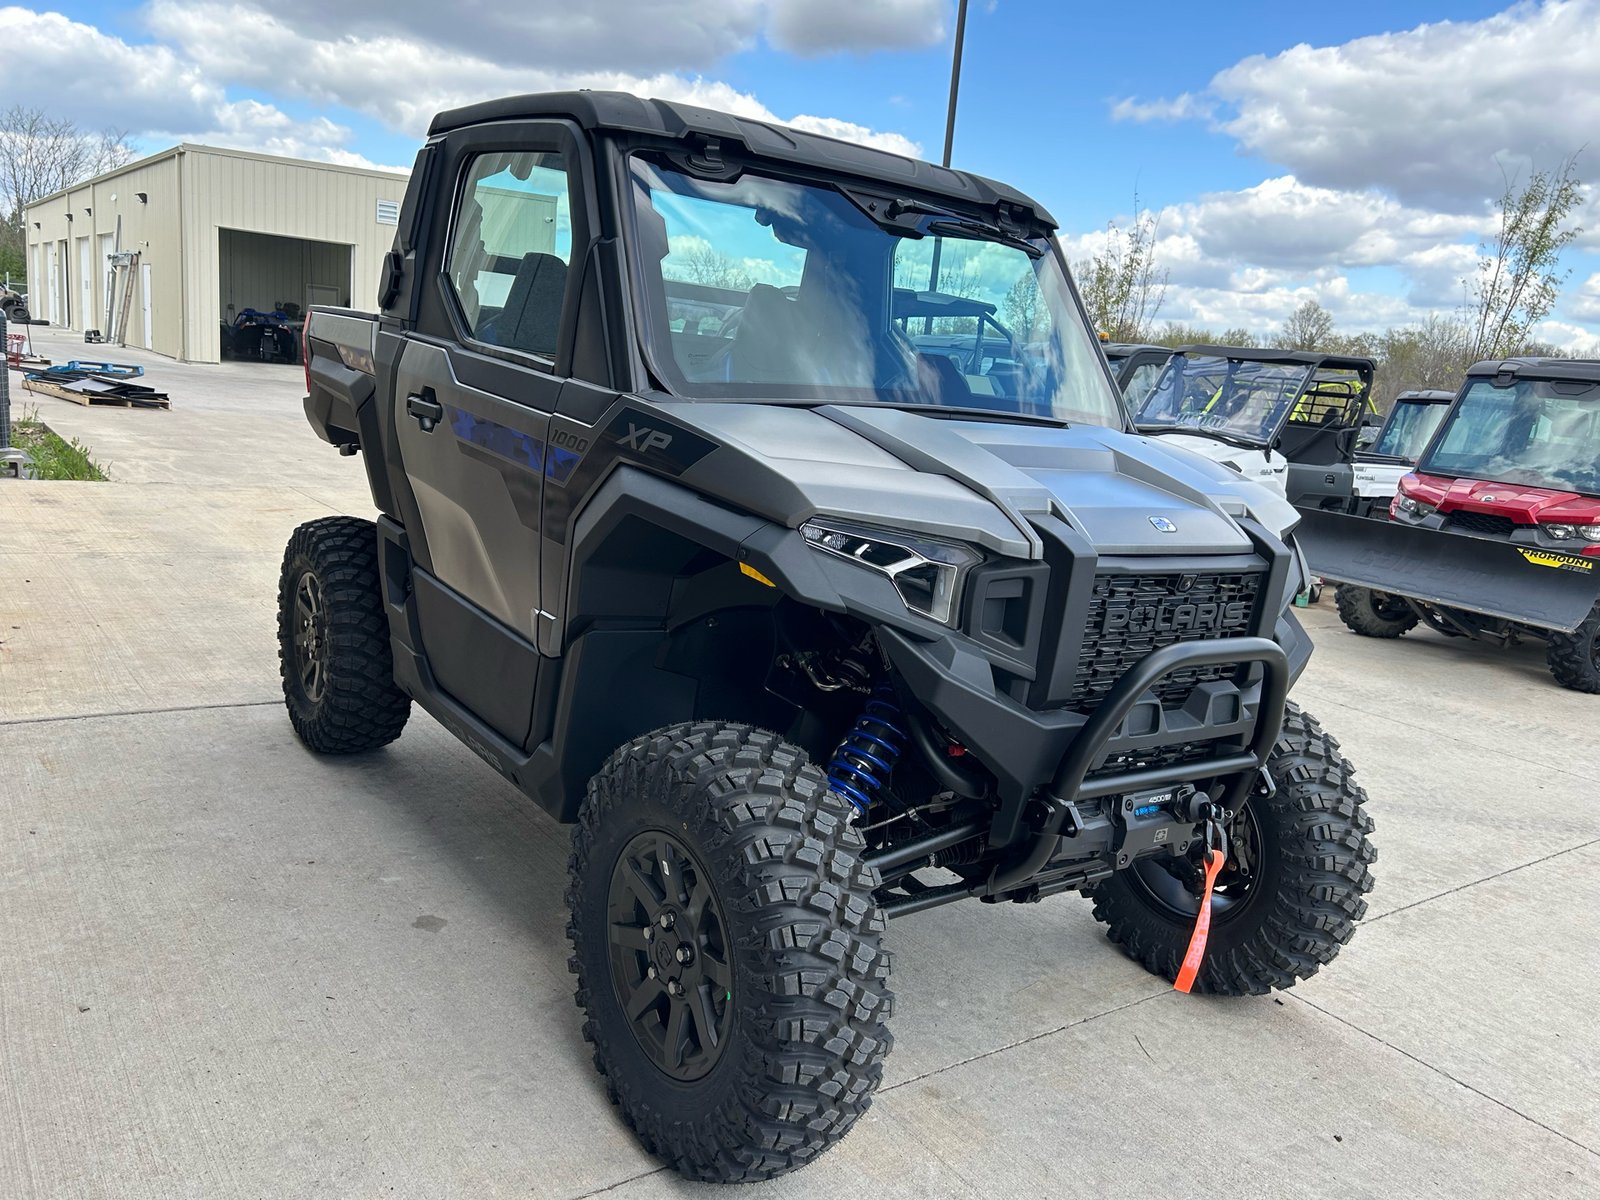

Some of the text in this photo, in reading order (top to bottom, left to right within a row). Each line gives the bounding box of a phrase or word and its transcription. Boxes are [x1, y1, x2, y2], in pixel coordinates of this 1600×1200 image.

[551, 428, 589, 452] 1000
[616, 422, 673, 453] XP
[1521, 549, 1592, 568] PROMOUNT
[1561, 564, 1591, 575] STEEL
[1102, 602, 1246, 635] POLARIS
